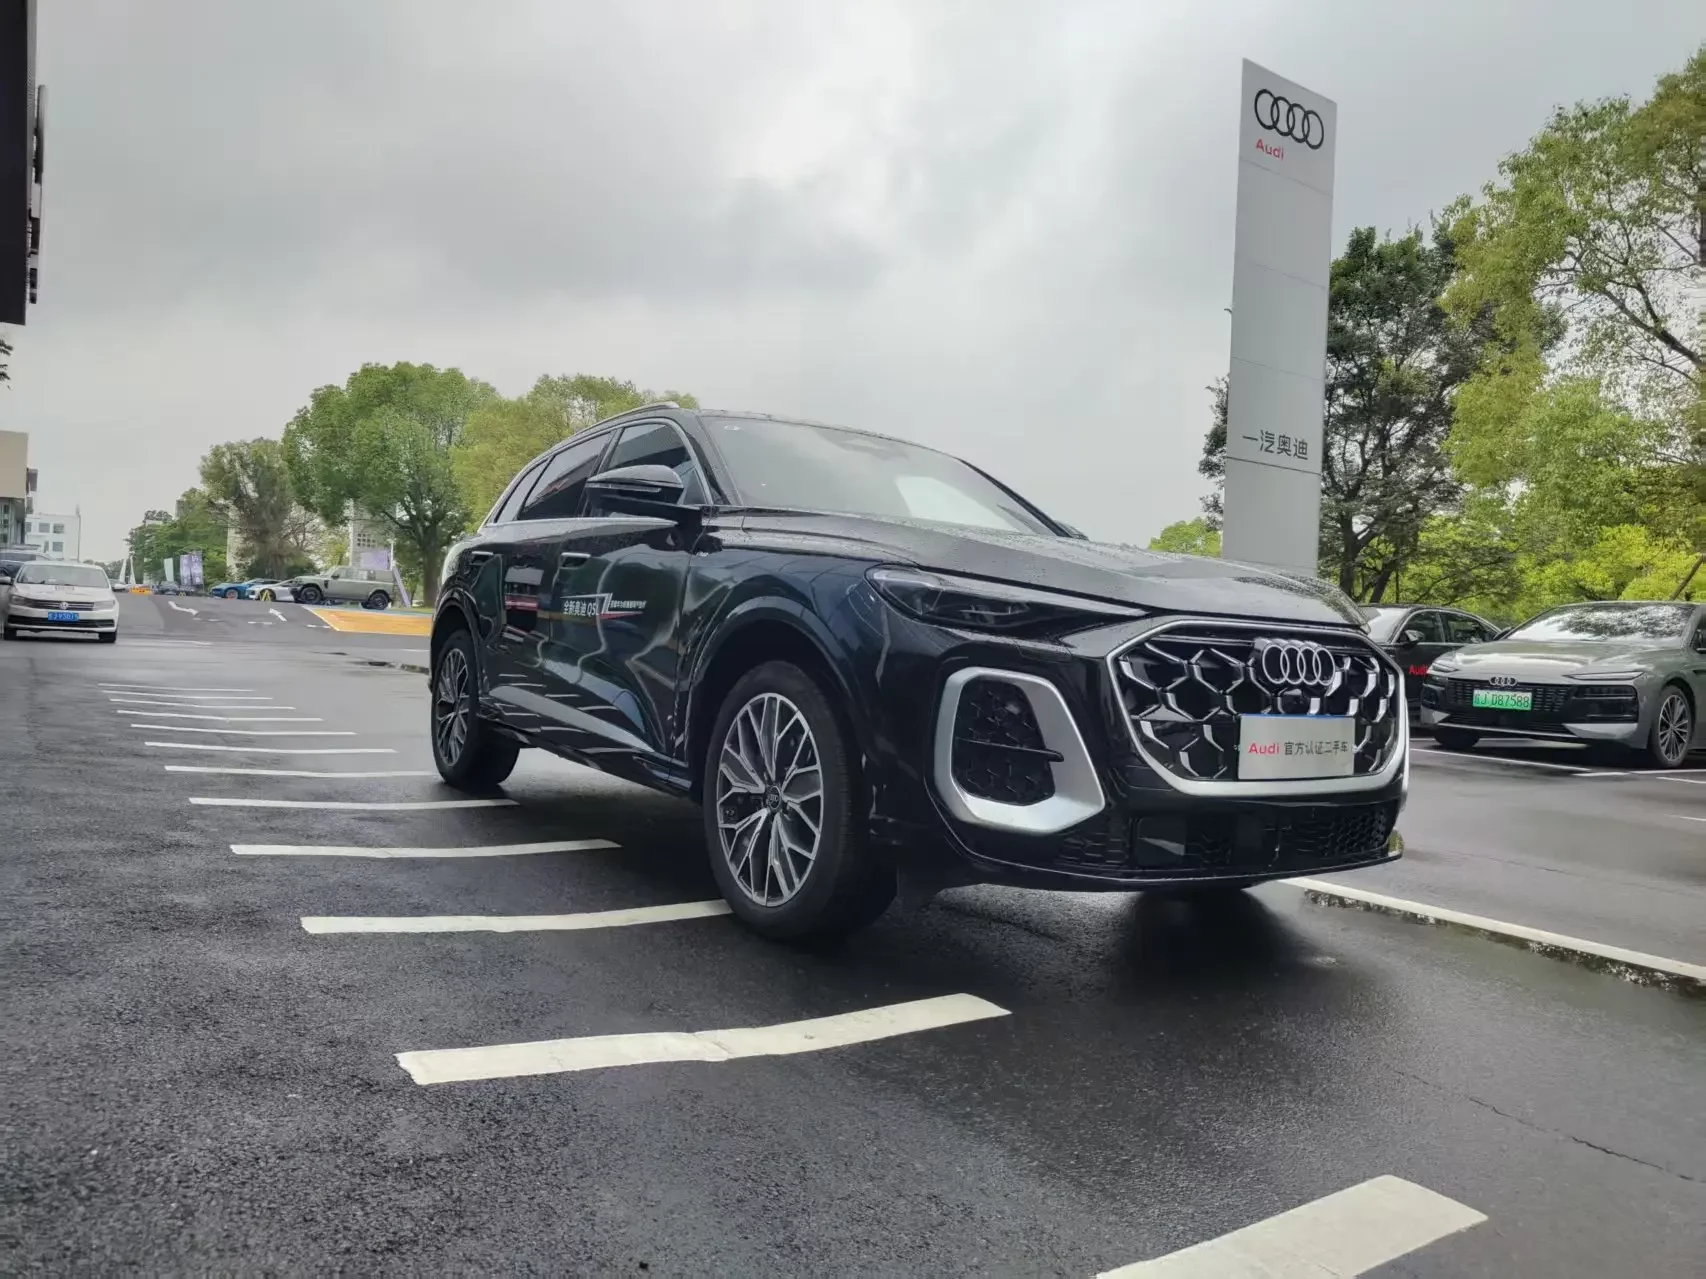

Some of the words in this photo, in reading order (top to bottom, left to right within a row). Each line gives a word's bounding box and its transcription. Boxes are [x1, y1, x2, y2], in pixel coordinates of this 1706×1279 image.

[1255, 138, 1284, 160] Audi
[1242, 429, 1308, 460] 一汽奥迪
[1248, 743, 1280, 754] Audi
[1284, 741, 1348, 756] 官方认证二手车
